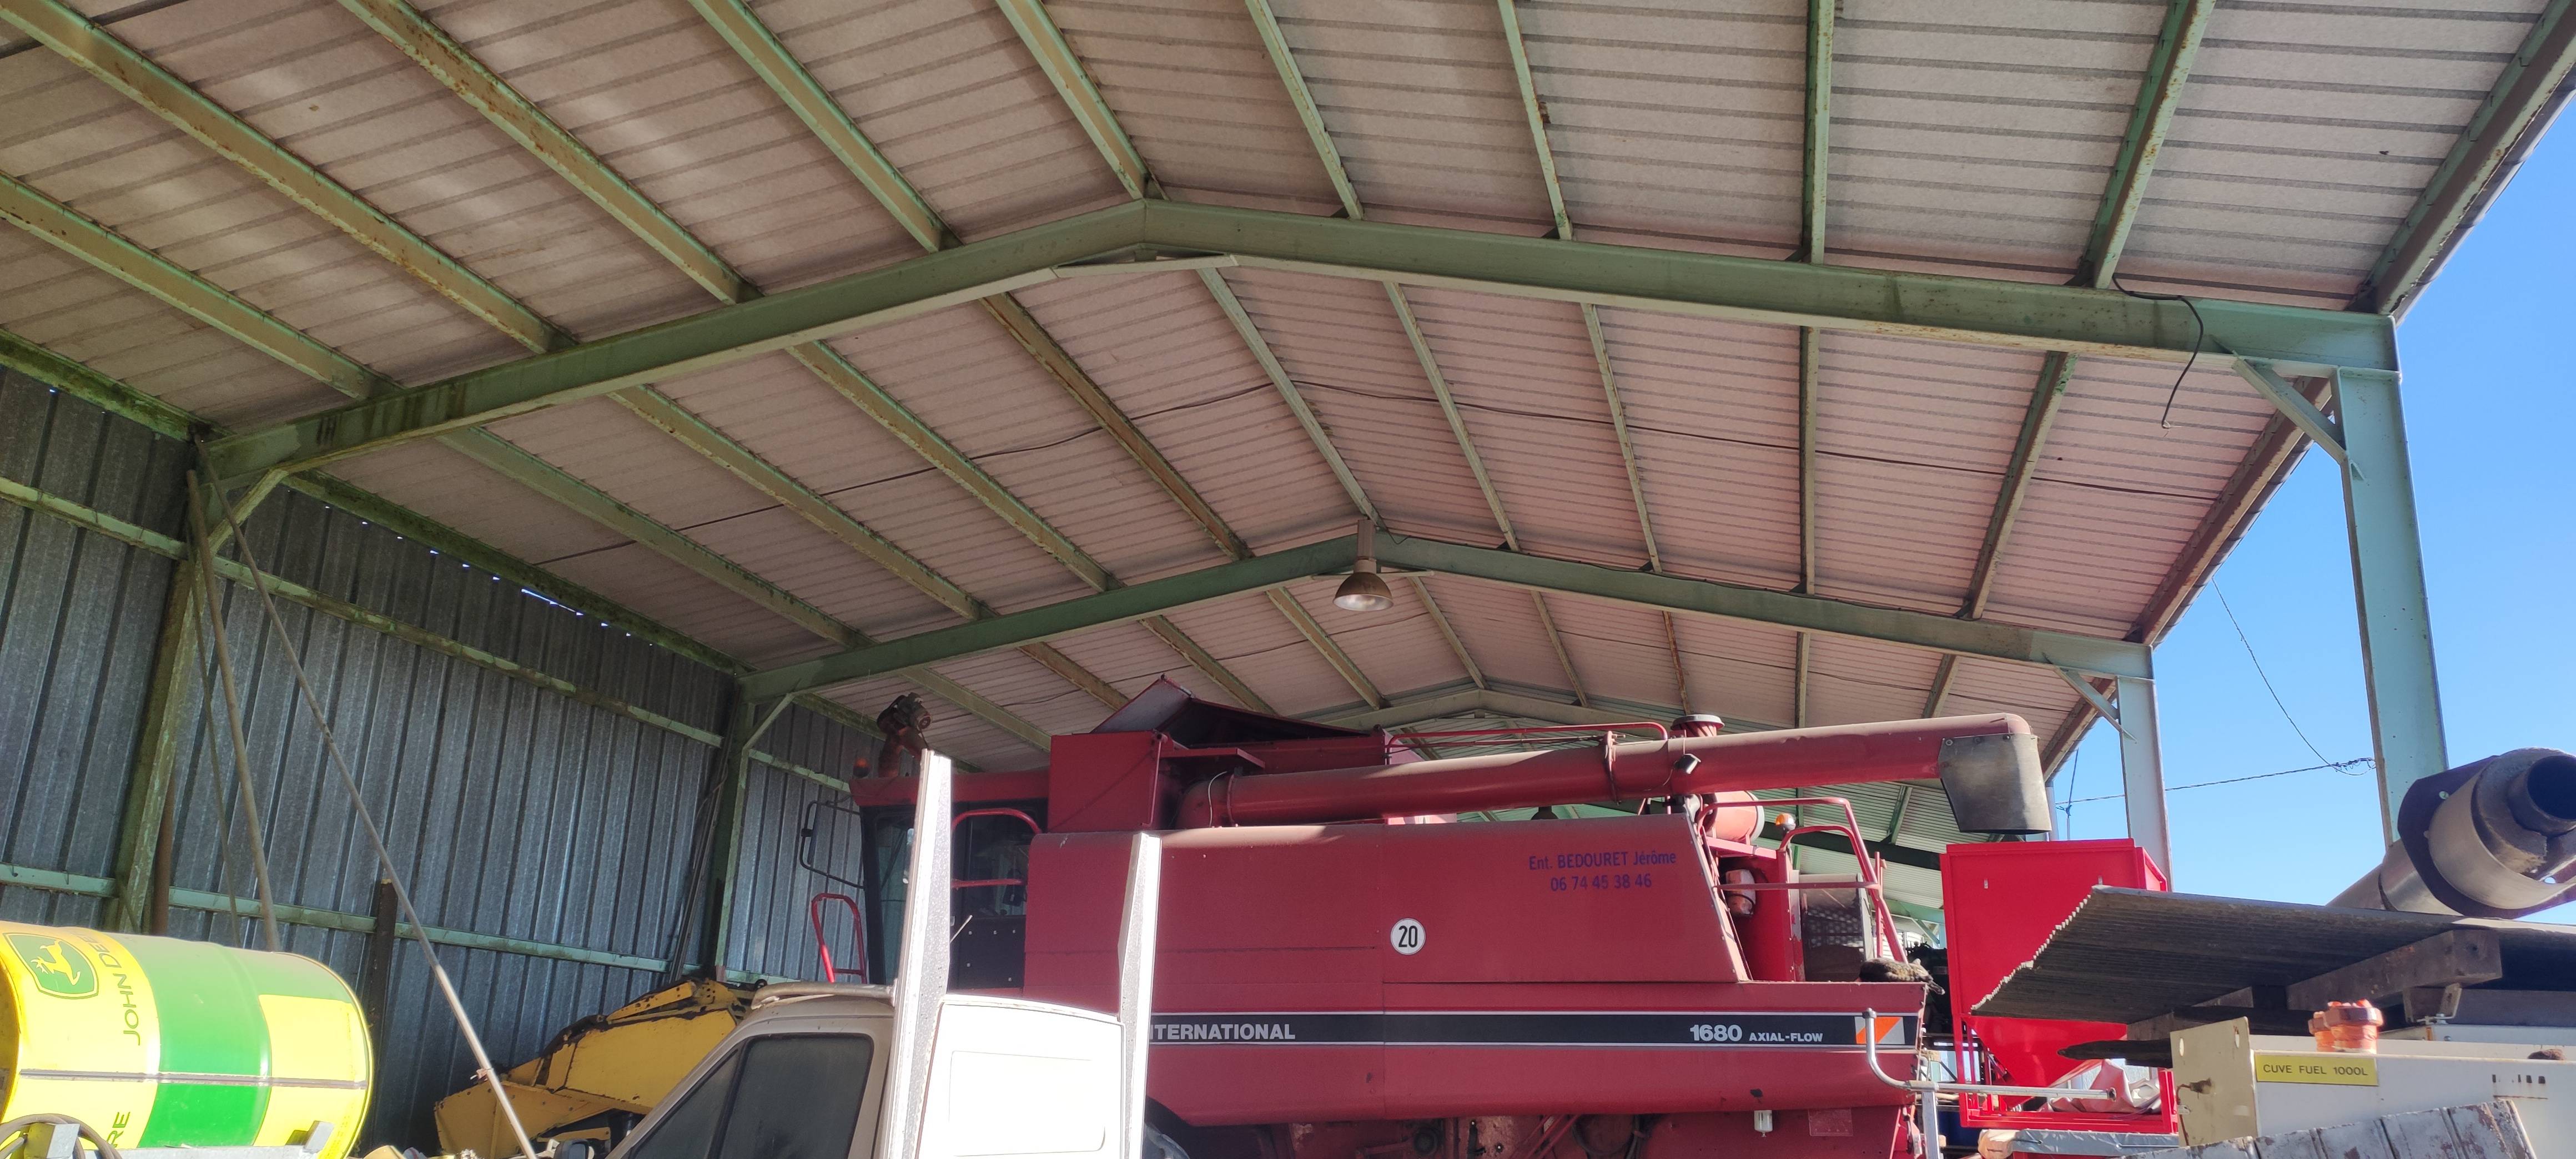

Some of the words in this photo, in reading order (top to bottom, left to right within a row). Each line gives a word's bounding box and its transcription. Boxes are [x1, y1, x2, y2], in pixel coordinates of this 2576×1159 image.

[1529, 855, 1553, 870] Ent.
[1557, 851, 1628, 869] BEDOURET
[1633, 850, 1676, 865] Jérôme
[1551, 876, 1567, 891] 06
[1572, 876, 1588, 890] 74
[1592, 875, 1609, 889] 45
[1614, 874, 1631, 889] 38
[1634, 873, 1652, 888] 46
[1398, 925, 1418, 948] 20
[113, 973, 140, 1046] JOHN
[1689, 1024, 1743, 1042] 1680
[1749, 1032, 1823, 1042] AXIAL-FLOW
[2263, 1064, 2292, 1074] CUVE
[2299, 1065, 2327, 1075] FUEL
[2333, 1066, 2368, 1076] 1000L
